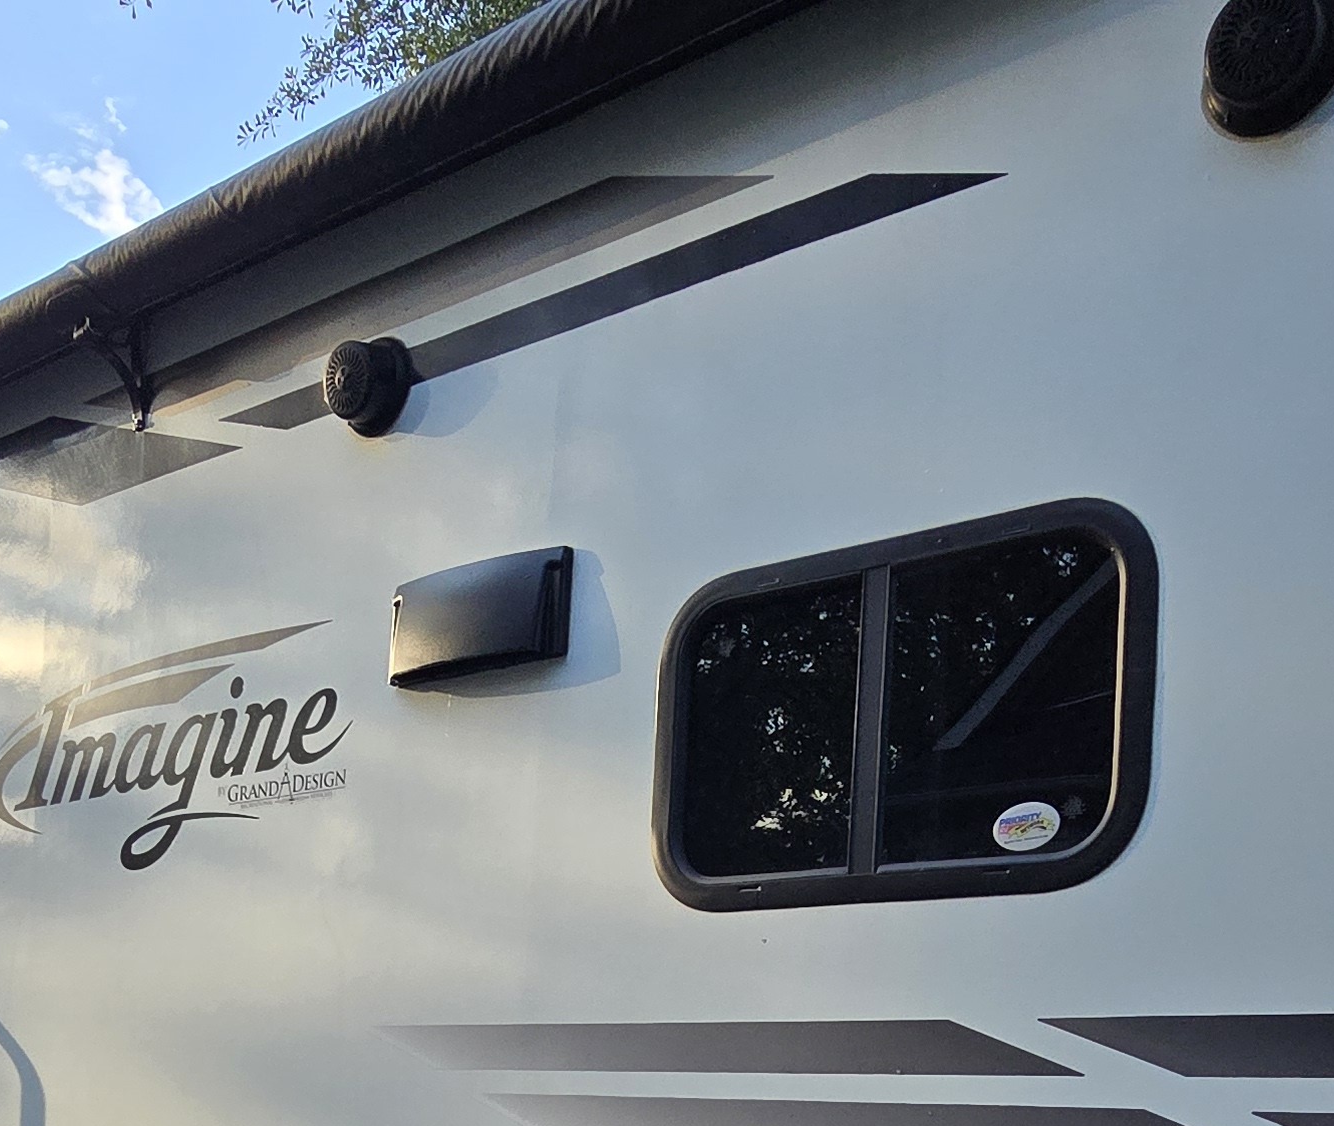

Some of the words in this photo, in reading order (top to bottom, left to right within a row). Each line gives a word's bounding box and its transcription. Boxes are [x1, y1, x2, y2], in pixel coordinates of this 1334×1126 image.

[13, 676, 353, 871] Imagine
[227, 780, 280, 803] GRAND
[292, 768, 347, 793] DESIGN
[1000, 811, 1042, 825] PRIORITY
